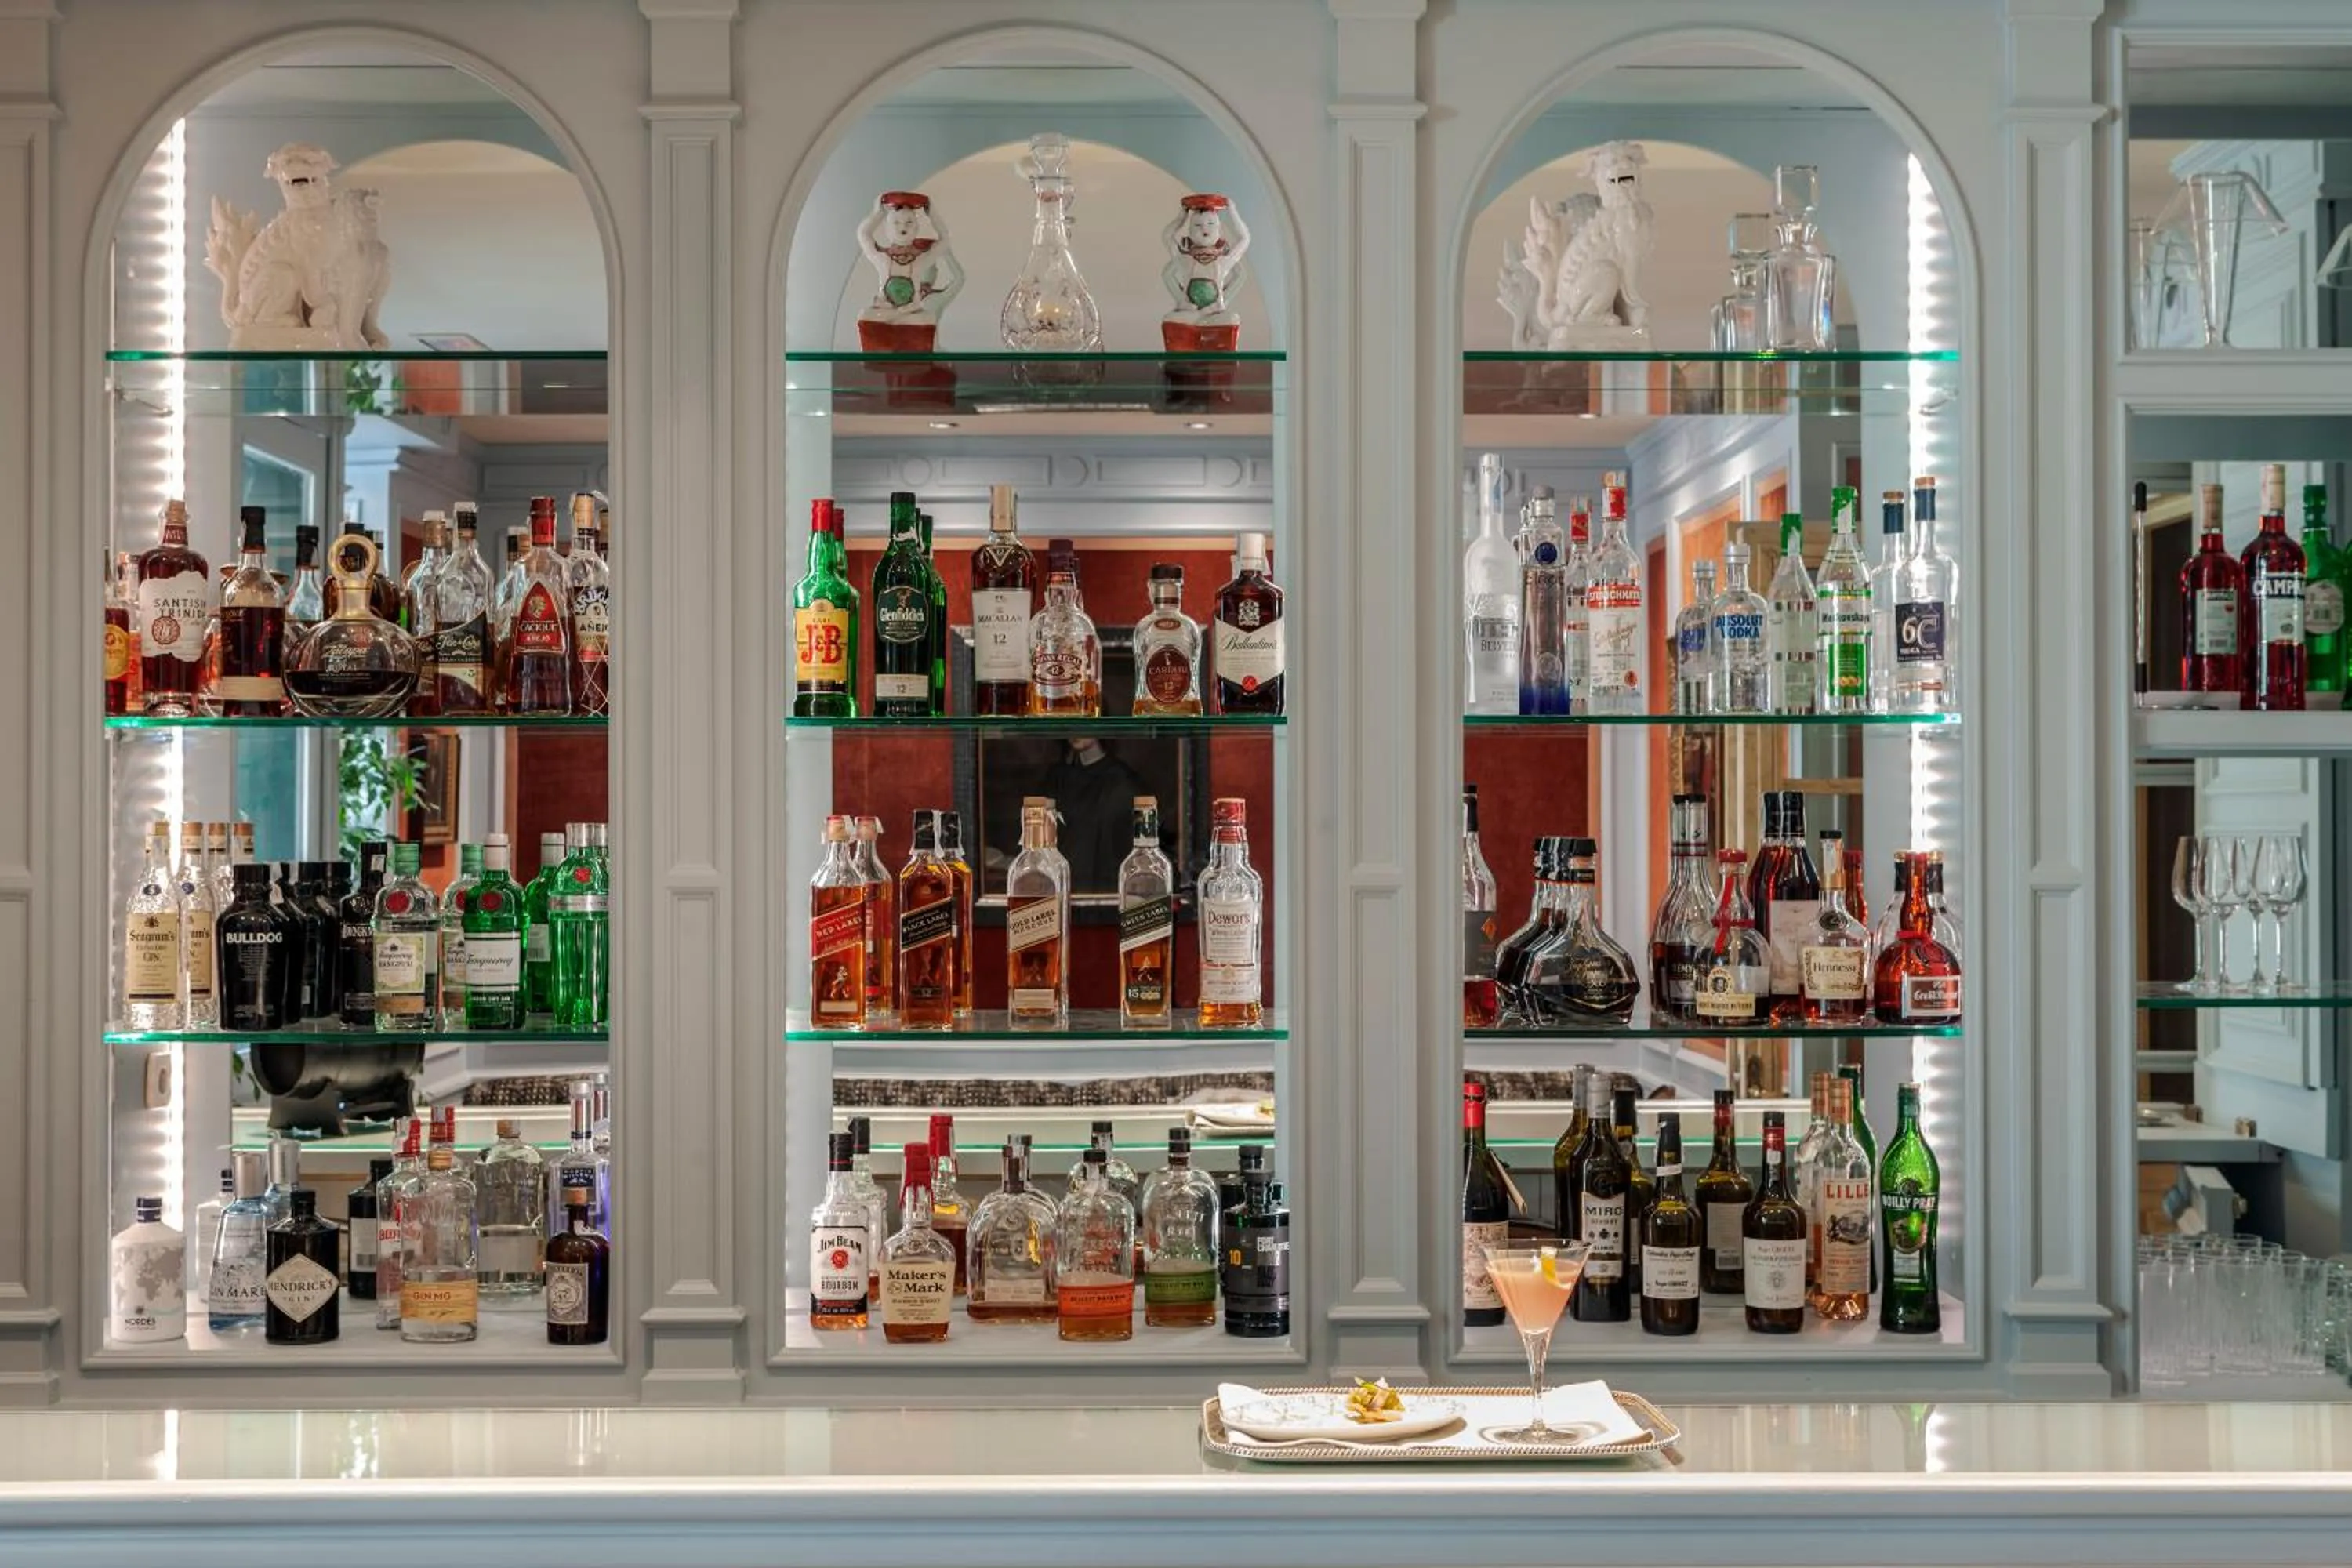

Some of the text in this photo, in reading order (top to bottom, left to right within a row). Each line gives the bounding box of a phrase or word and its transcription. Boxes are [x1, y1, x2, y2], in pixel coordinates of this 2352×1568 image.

[2252, 579, 2305, 596] CAMPA
[574, 587, 609, 615] BRUGA
[879, 607, 924, 622] Glenfiddich
[1715, 615, 1763, 627] ABSOLUT
[993, 633, 1007, 646] 12
[1719, 627, 1760, 639] VODKA
[926, 912, 949, 924] LABEL
[1031, 909, 1056, 923] LABEL
[1146, 906, 1168, 918] LABEL
[816, 926, 835, 938] RED
[835, 916, 862, 931] LABEL
[225, 932, 283, 944] BULLDOG
[466, 953, 514, 967] Tanqueray
[1813, 962, 1857, 973] Hennessy
[1826, 1184, 1869, 1199] LILLE
[1882, 1193, 1912, 1207] NOILLY
[818, 1235, 862, 1254] JIM BEAM
[1229, 1249, 1241, 1265] 10
[887, 1270, 946, 1280] Maker's
[267, 1279, 334, 1292] HENDRICK'S
[904, 1283, 946, 1293] Mark
[412, 1291, 452, 1300] GIN MG
